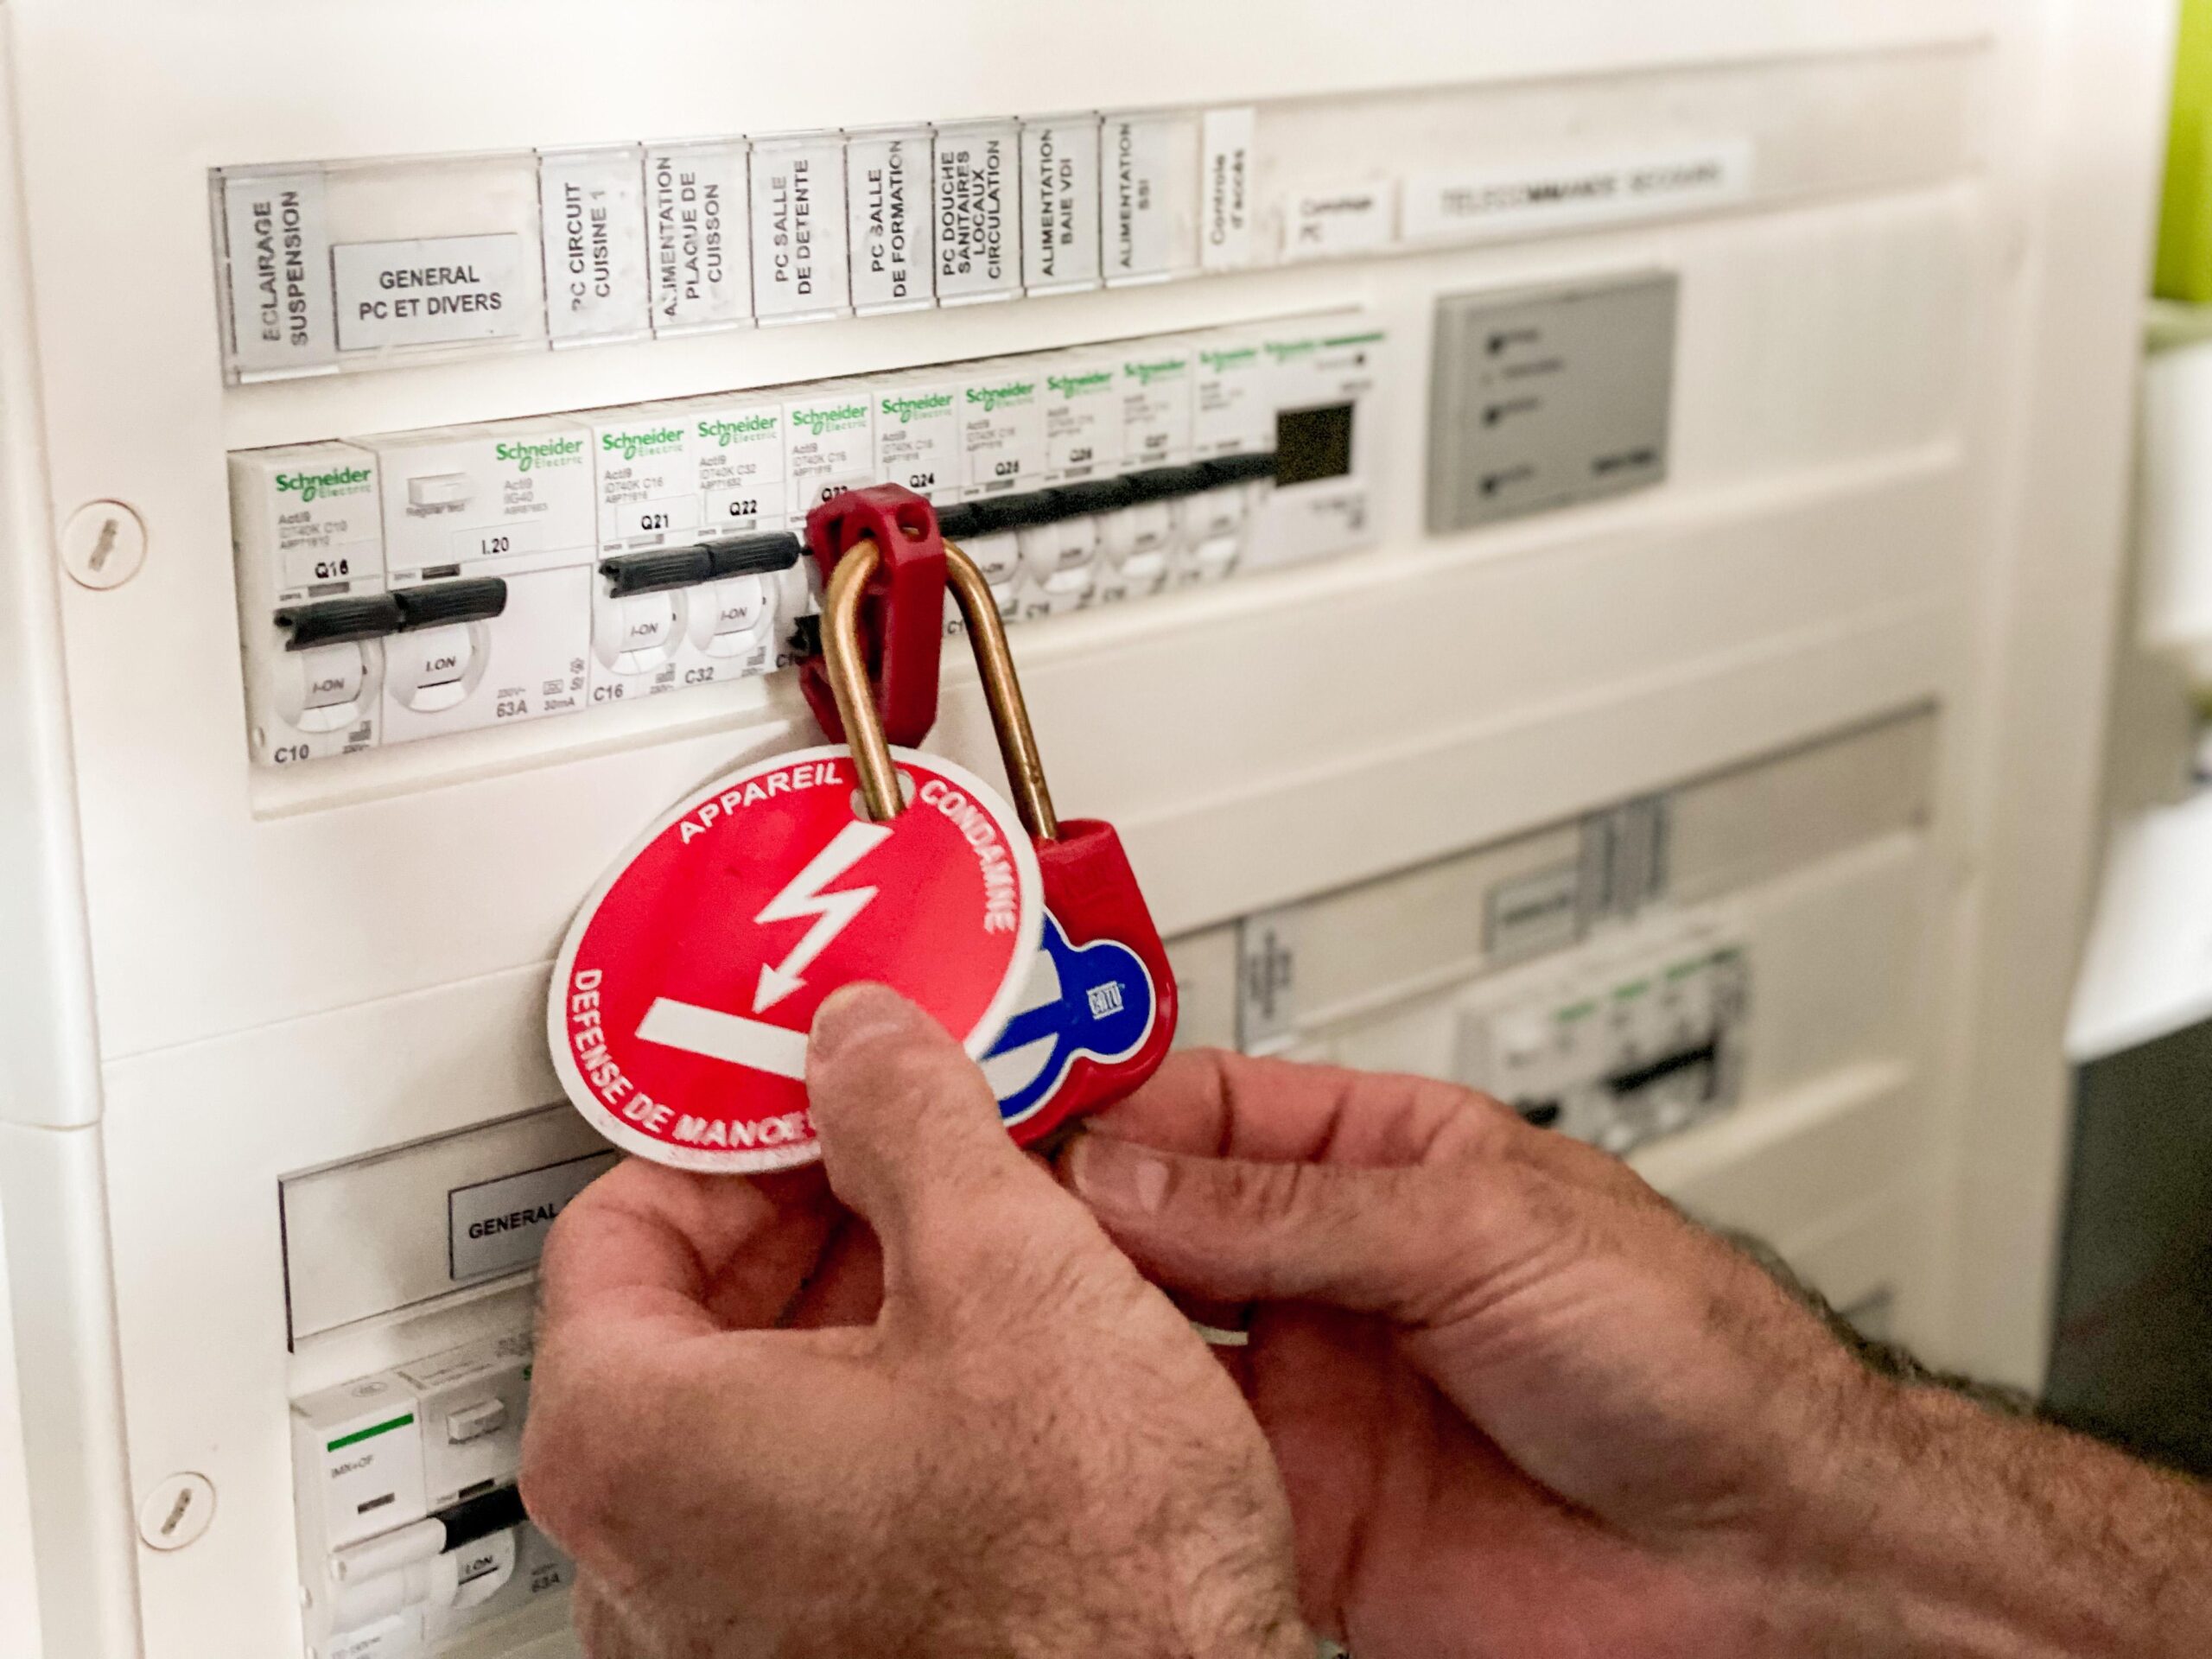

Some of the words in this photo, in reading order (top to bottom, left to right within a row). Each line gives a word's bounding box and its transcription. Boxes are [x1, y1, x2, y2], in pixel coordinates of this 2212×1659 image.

[681, 172, 696, 203] DE
[1058, 158, 1073, 193] VDI
[772, 175, 788, 250] SALLE
[794, 159, 811, 260] DETENTE
[889, 140, 906, 265] FORMATION
[941, 151, 956, 245] DOUCHE
[957, 149, 971, 275] SANITAIRES
[972, 168, 986, 256] LOCAUX
[986, 140, 1001, 280] CIRCULATION
[1039, 129, 1055, 277] ALIMENTATION
[1119, 123, 1133, 269] ALIMENTATION
[565, 181, 584, 275] CIRCUIT
[657, 157, 677, 317] ALIMENTATION
[704, 184, 723, 283] CUISSON
[1060, 198, 1073, 245] BAIE
[282, 191, 308, 346] SUSPENSION
[591, 208, 610, 297] CUISINE
[682, 208, 700, 300] PLAQUE
[774, 255, 789, 283] PC
[871, 245, 885, 272] PC
[943, 249, 956, 276] PC
[253, 200, 281, 342] ECLAIRAGE
[378, 264, 480, 291] GENERAL
[797, 266, 812, 295] DE
[893, 270, 907, 298] DE
[359, 302, 388, 321] PC
[395, 297, 421, 318] ET
[427, 291, 503, 316] DIVERS
[966, 380, 1036, 413] Schneider
[1046, 372, 1113, 400] Schneider
[792, 404, 868, 435] Schneider
[881, 392, 954, 424] Schneider
[602, 428, 685, 461] Schneider
[697, 414, 779, 448] Schneider
[496, 438, 583, 472] Schneider
[276, 467, 372, 502] Schneider
[909, 472, 935, 489] Q24
[641, 513, 670, 531] Q21
[729, 499, 758, 517] Q22
[593, 683, 624, 702] C16
[684, 666, 715, 684] C32
[273, 743, 311, 764] C10
[679, 761, 844, 845] APPAREIL
[919, 779, 1018, 934] CONDAMNE
[572, 969, 635, 1105] DEFENSE
[621, 1091, 676, 1134] DE
[468, 1203, 560, 1240] GENERAL
